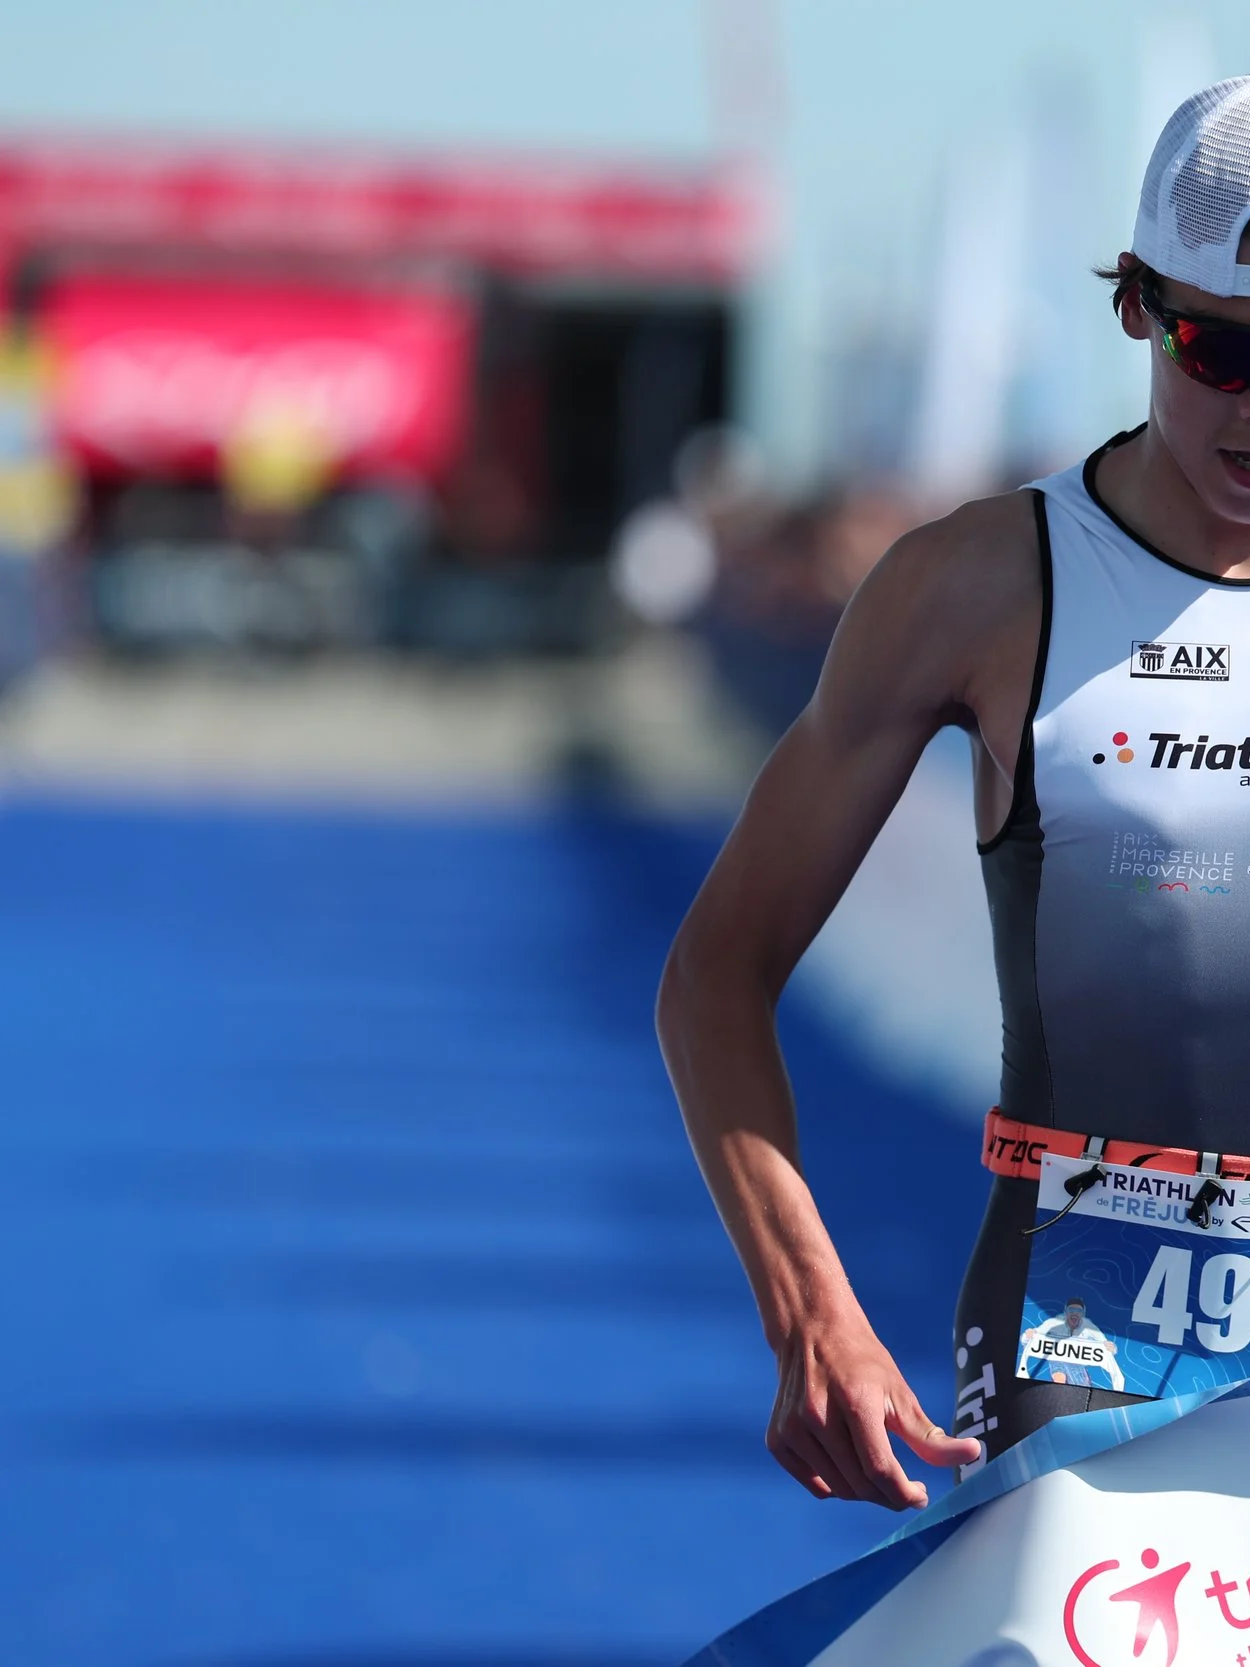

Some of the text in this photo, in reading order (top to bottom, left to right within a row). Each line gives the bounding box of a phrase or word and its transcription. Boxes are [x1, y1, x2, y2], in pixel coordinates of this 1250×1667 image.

[1170, 645, 1227, 669] AIX
[1182, 668, 1227, 676] PROVENCE
[1119, 862, 1234, 881] PROVENCE
[1100, 1171, 1236, 1208] TRIATHLN
[1096, 1198, 1110, 1207] de
[1111, 1194, 1202, 1227] FRÉJU
[1212, 1216, 1225, 1227] by
[1031, 1339, 1104, 1363] JEUNES
